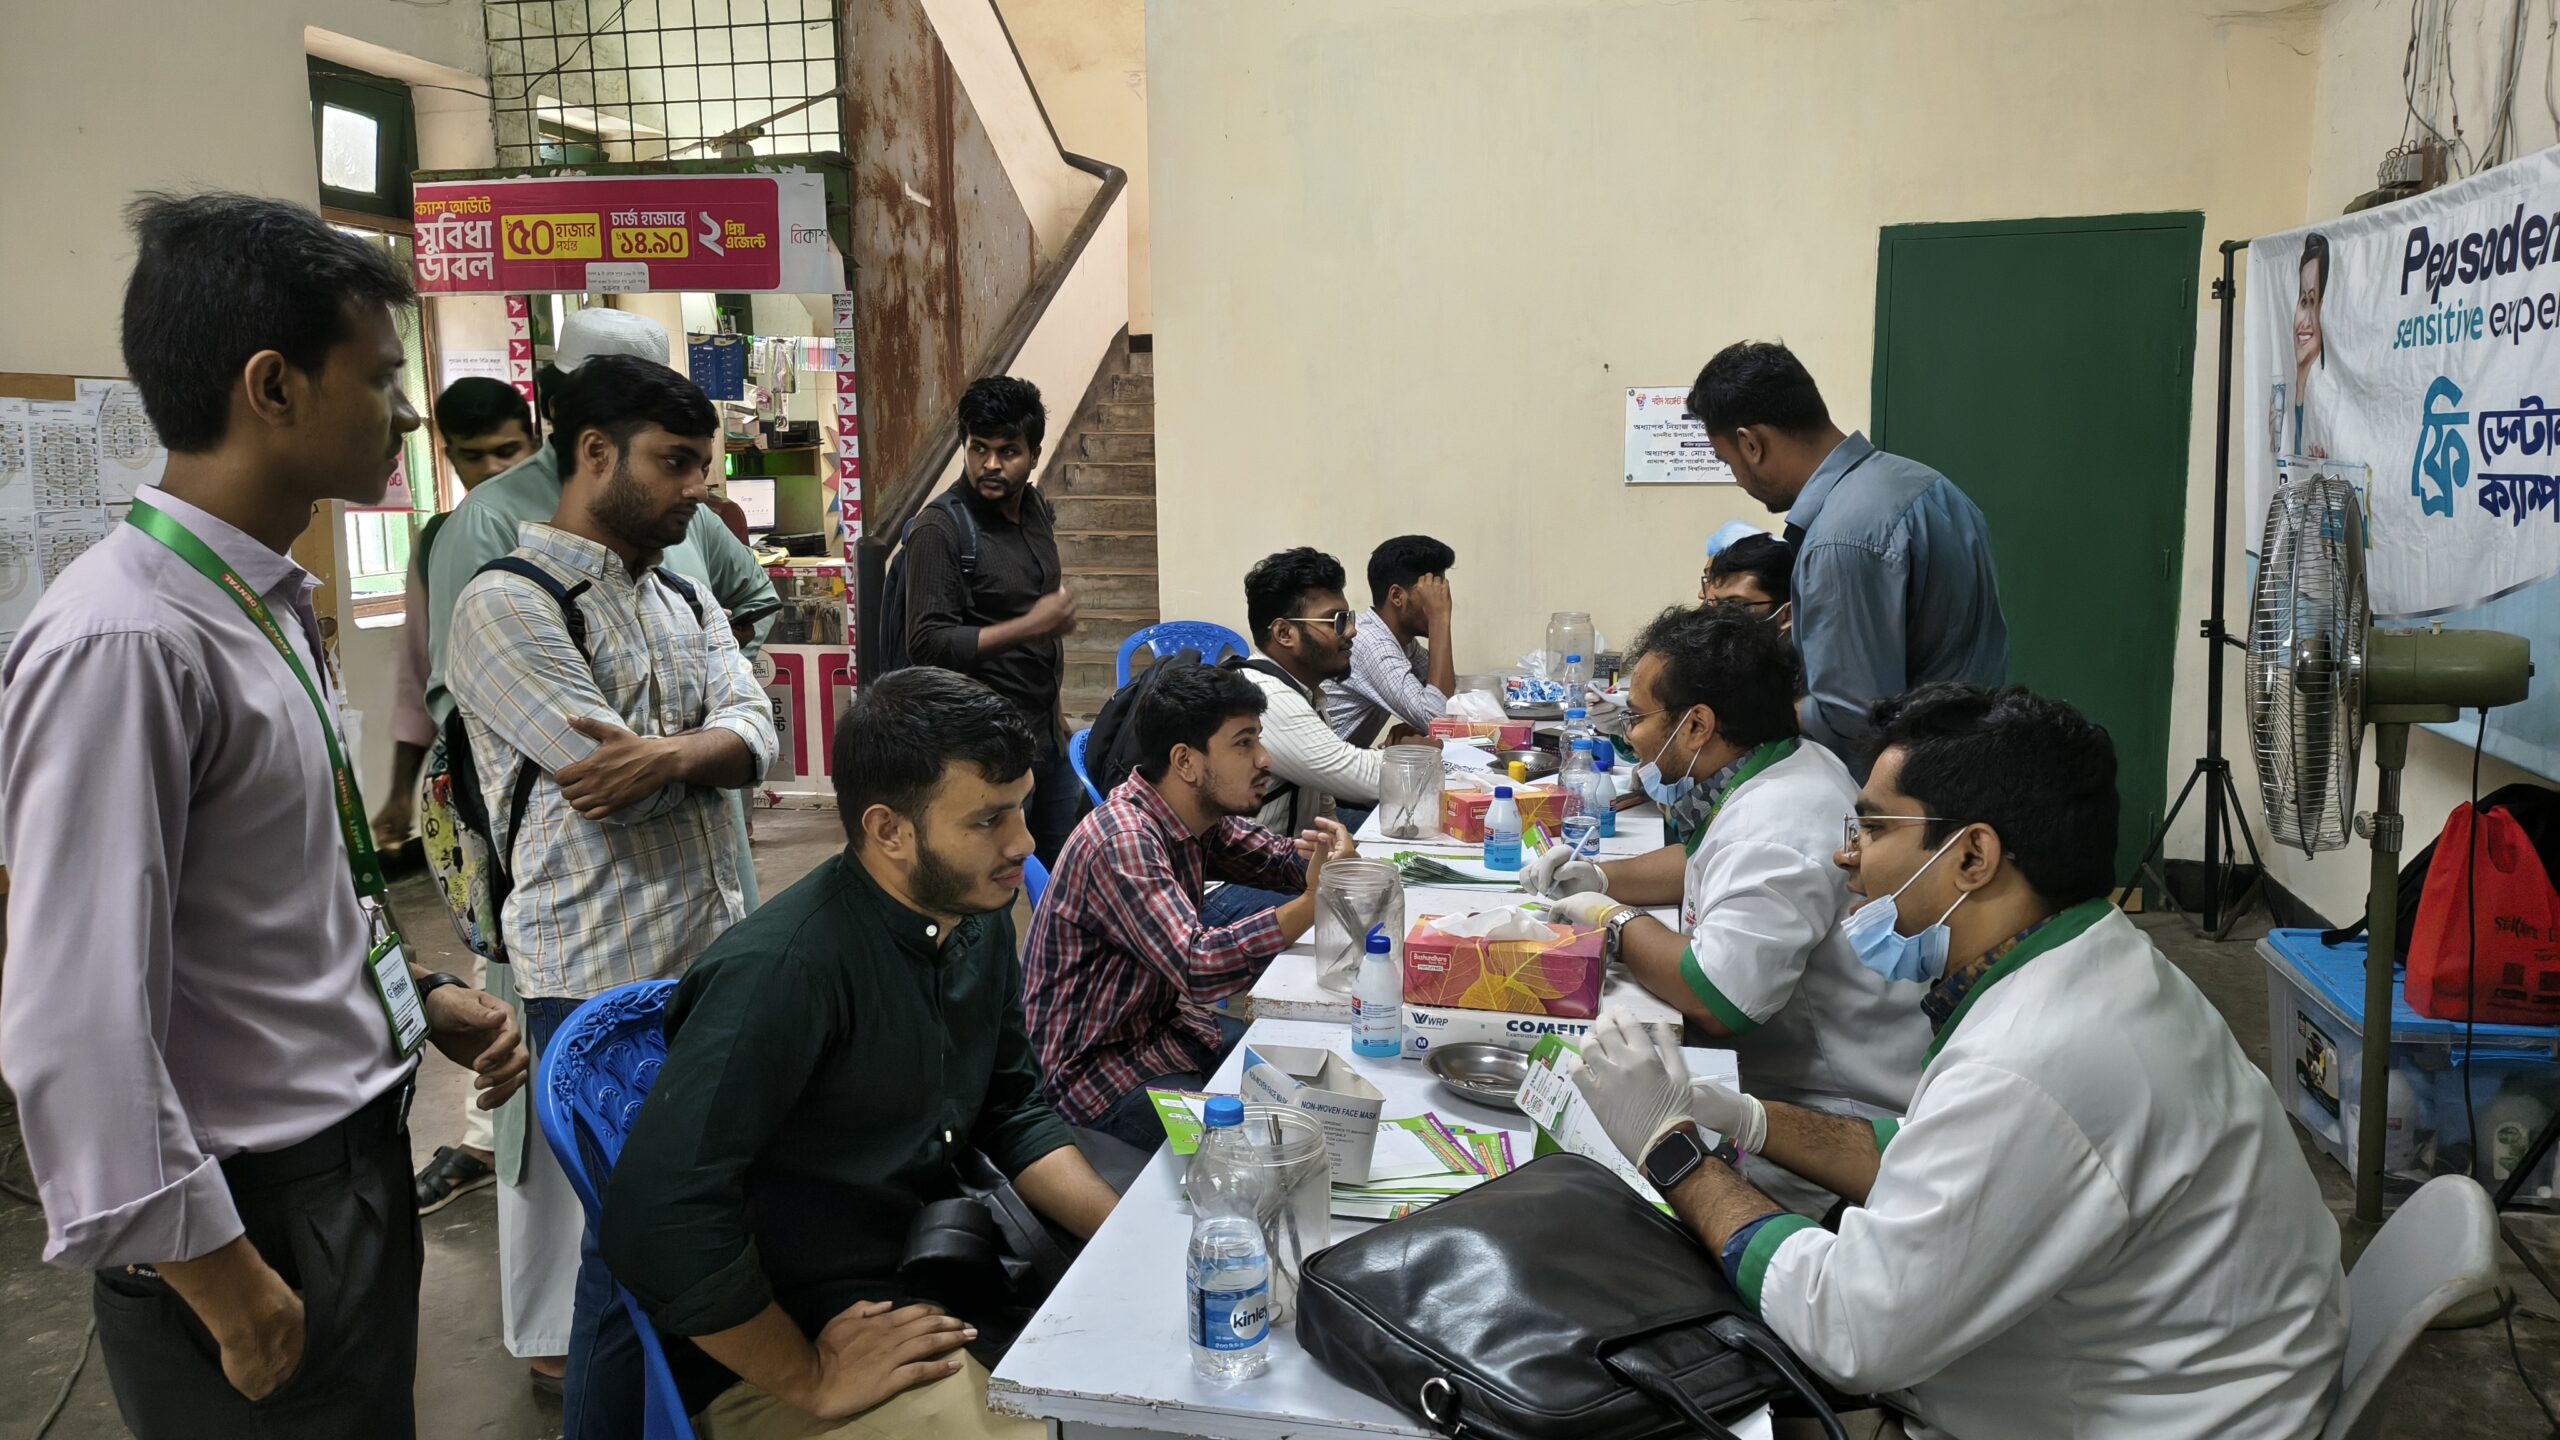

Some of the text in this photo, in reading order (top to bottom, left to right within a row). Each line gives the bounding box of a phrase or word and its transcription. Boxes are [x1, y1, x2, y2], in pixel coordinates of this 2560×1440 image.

[415, 196, 491, 215] ক্যাশ আউটে
[610, 208, 686, 226] চার্জ হাজারে
[415, 212, 492, 255] সুবিধা
[555, 222, 596, 238] হাজার
[698, 211, 724, 257] ২
[724, 219, 745, 236] প্রিয়
[725, 233, 766, 249] এজেন্টে
[416, 252, 494, 281] ডাবল
[2393, 298, 2484, 350] sensitive
[2411, 376, 2470, 518] ফ্রি
[1428, 1018, 1449, 1027] WRP
[1418, 1038, 1427, 1047] M
[1301, 1101, 1378, 1120] NON-WOVEN FACE MASK
